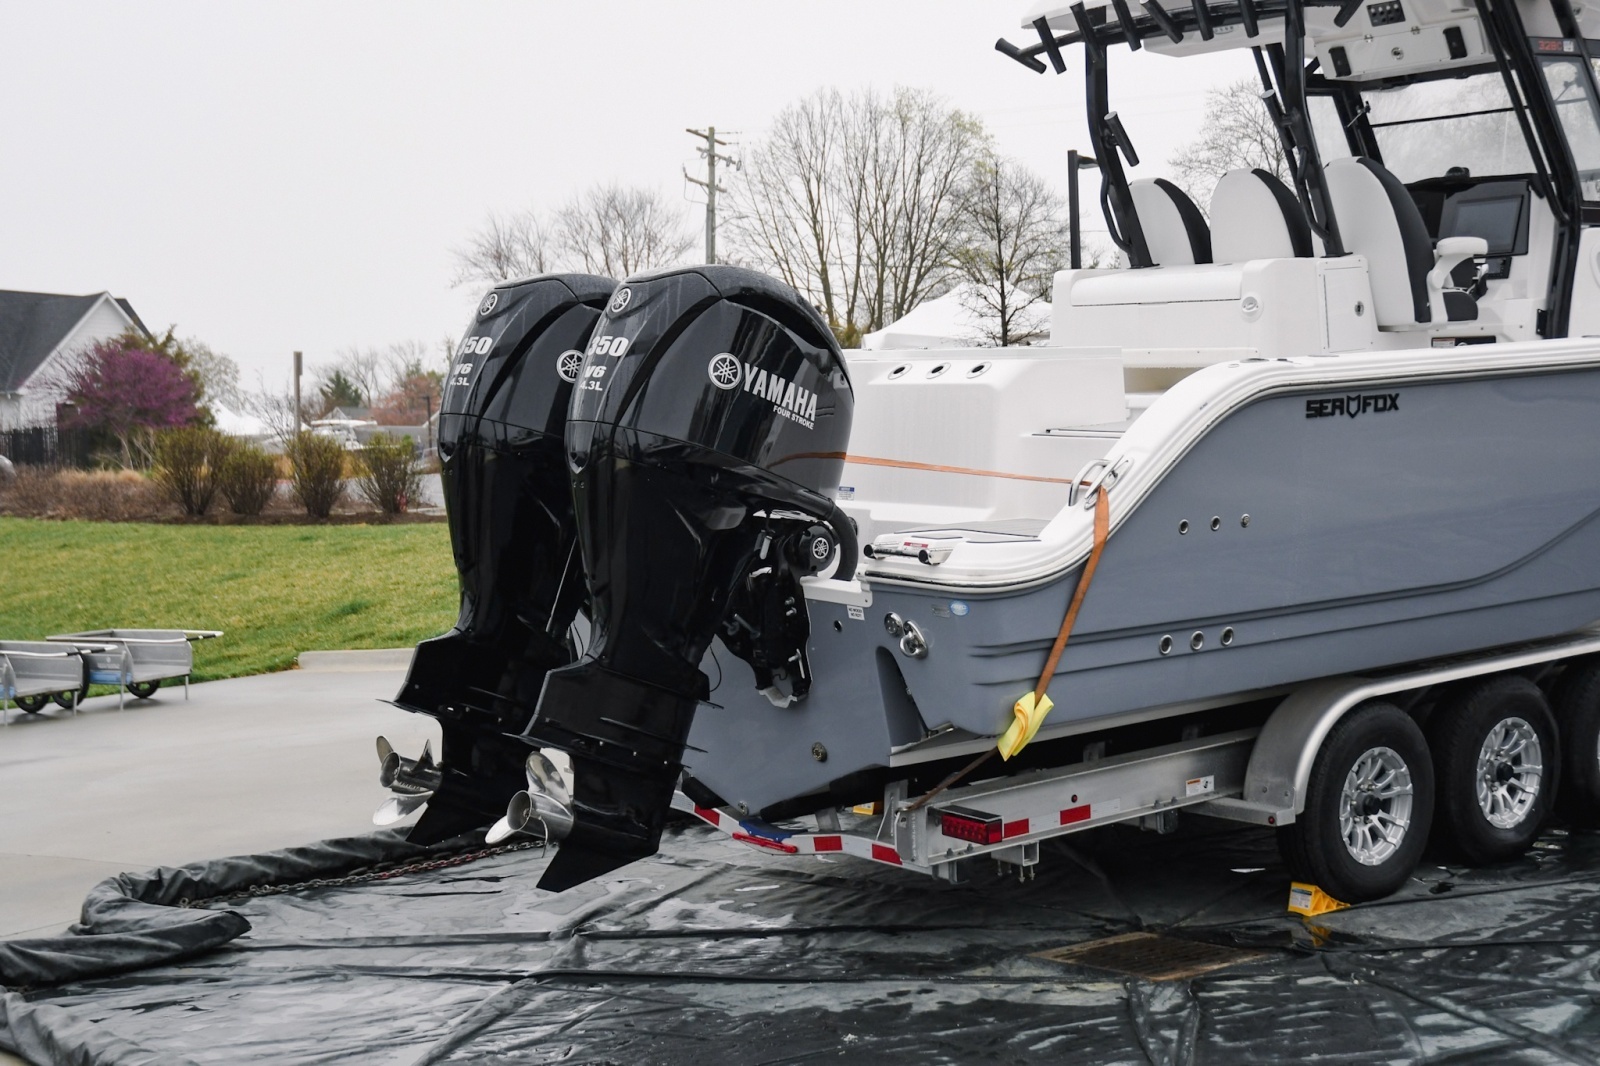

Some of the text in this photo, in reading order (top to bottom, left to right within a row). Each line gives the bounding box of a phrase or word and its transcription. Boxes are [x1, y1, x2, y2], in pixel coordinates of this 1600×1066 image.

[588, 335, 629, 357] 350
[584, 365, 607, 378] V6
[580, 380, 603, 391] 4.3L
[743, 362, 818, 422] YAMAHA
[773, 404, 815, 431] FOUR STROKE
[1305, 393, 1400, 419] SEA FOX
